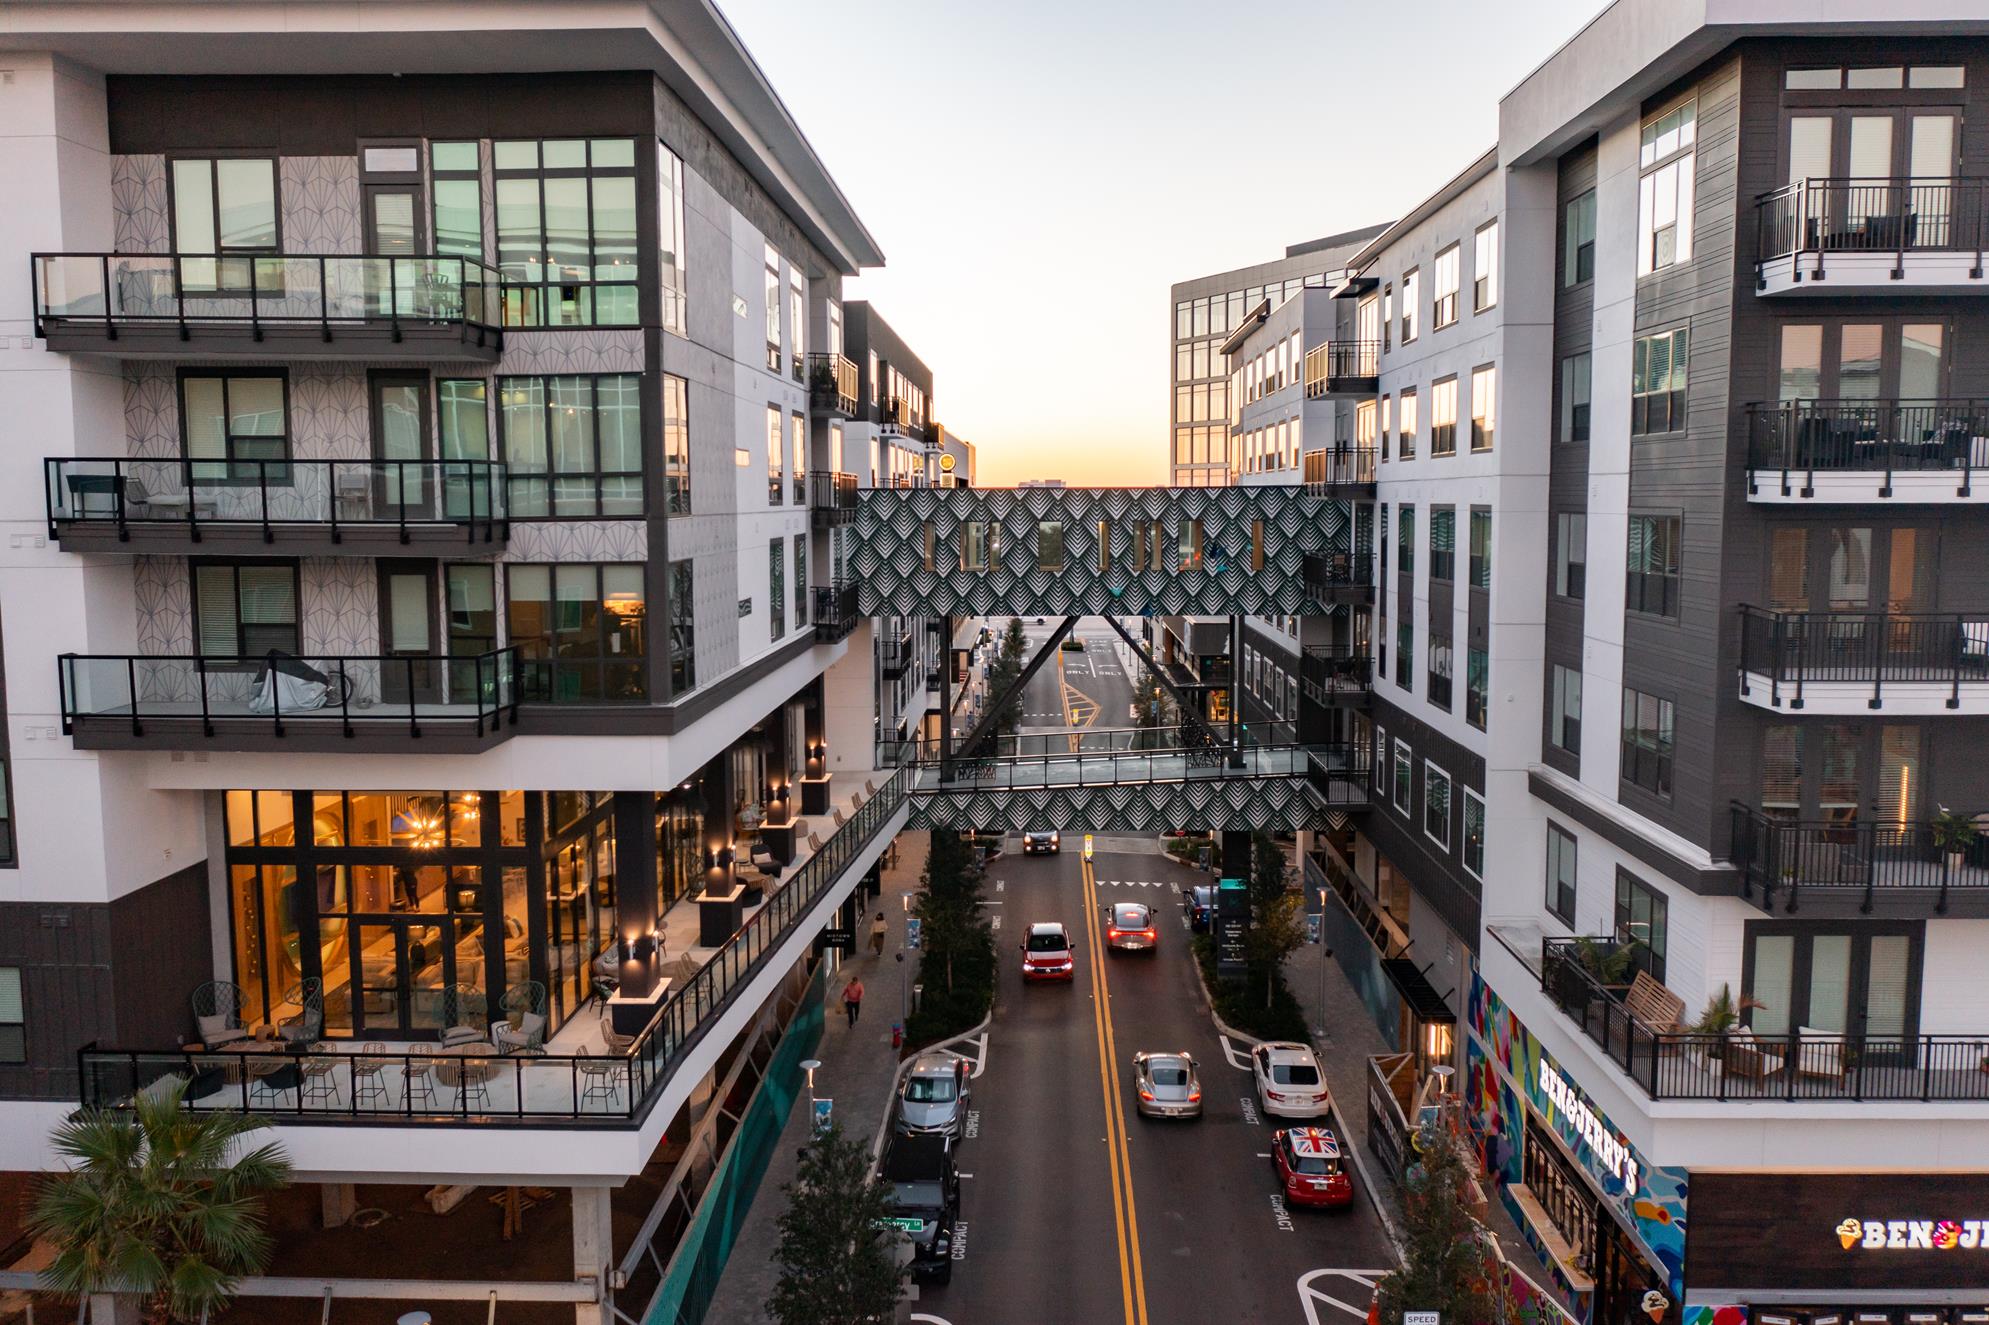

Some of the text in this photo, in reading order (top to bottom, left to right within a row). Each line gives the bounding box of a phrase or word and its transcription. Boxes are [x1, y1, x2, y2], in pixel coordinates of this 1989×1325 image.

[965, 1109, 980, 1139] COMPACT
[1240, 1098, 1260, 1126] COMPACT
[1270, 1194, 1294, 1232] COMPACT
[951, 1220, 969, 1260] COMPACT
